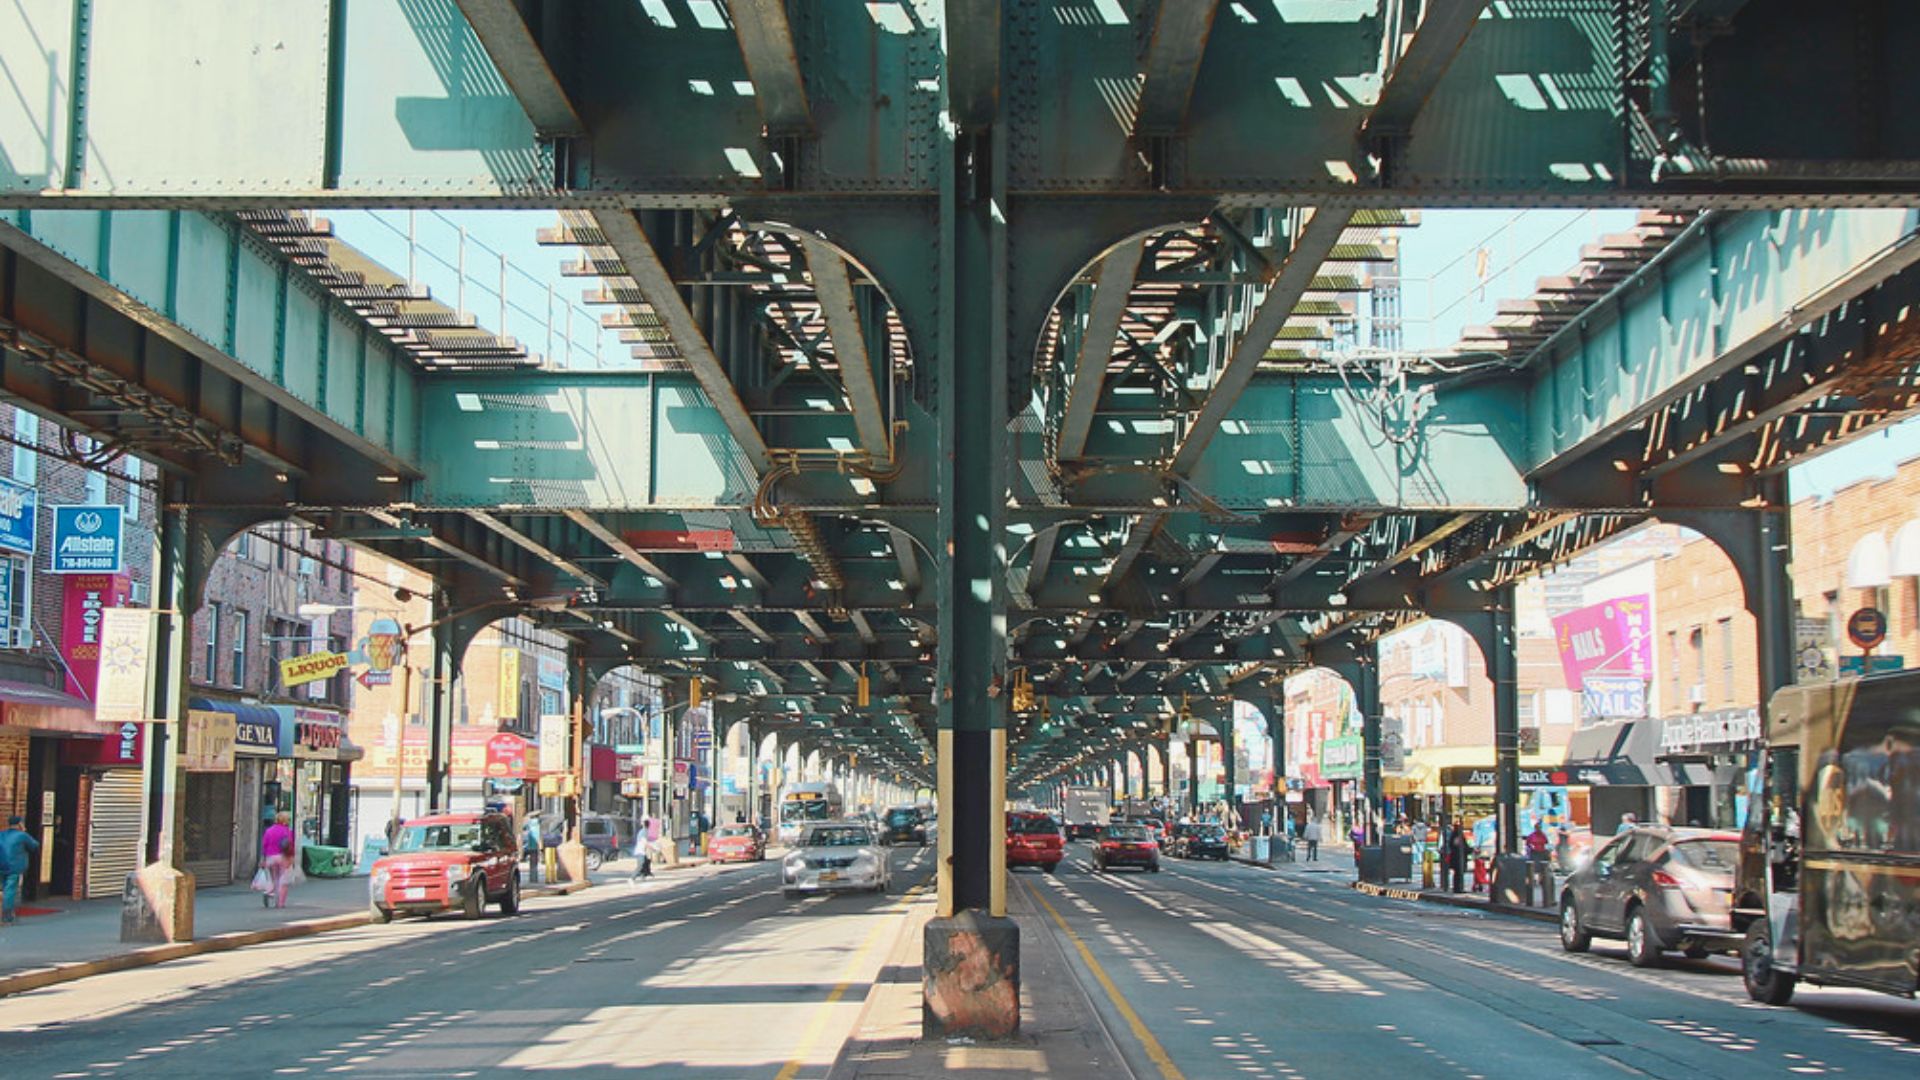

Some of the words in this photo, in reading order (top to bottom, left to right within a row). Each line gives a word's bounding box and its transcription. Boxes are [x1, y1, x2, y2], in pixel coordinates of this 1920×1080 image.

[60, 536, 115, 553] Allstate
[1570, 627, 1606, 661] NAILS
[1626, 613, 1645, 676] NAILS
[287, 654, 348, 678] LIQUOR
[1582, 689, 1644, 718] NAILS
[386, 757, 471, 766] GRORY
[1469, 769, 1496, 785] App
